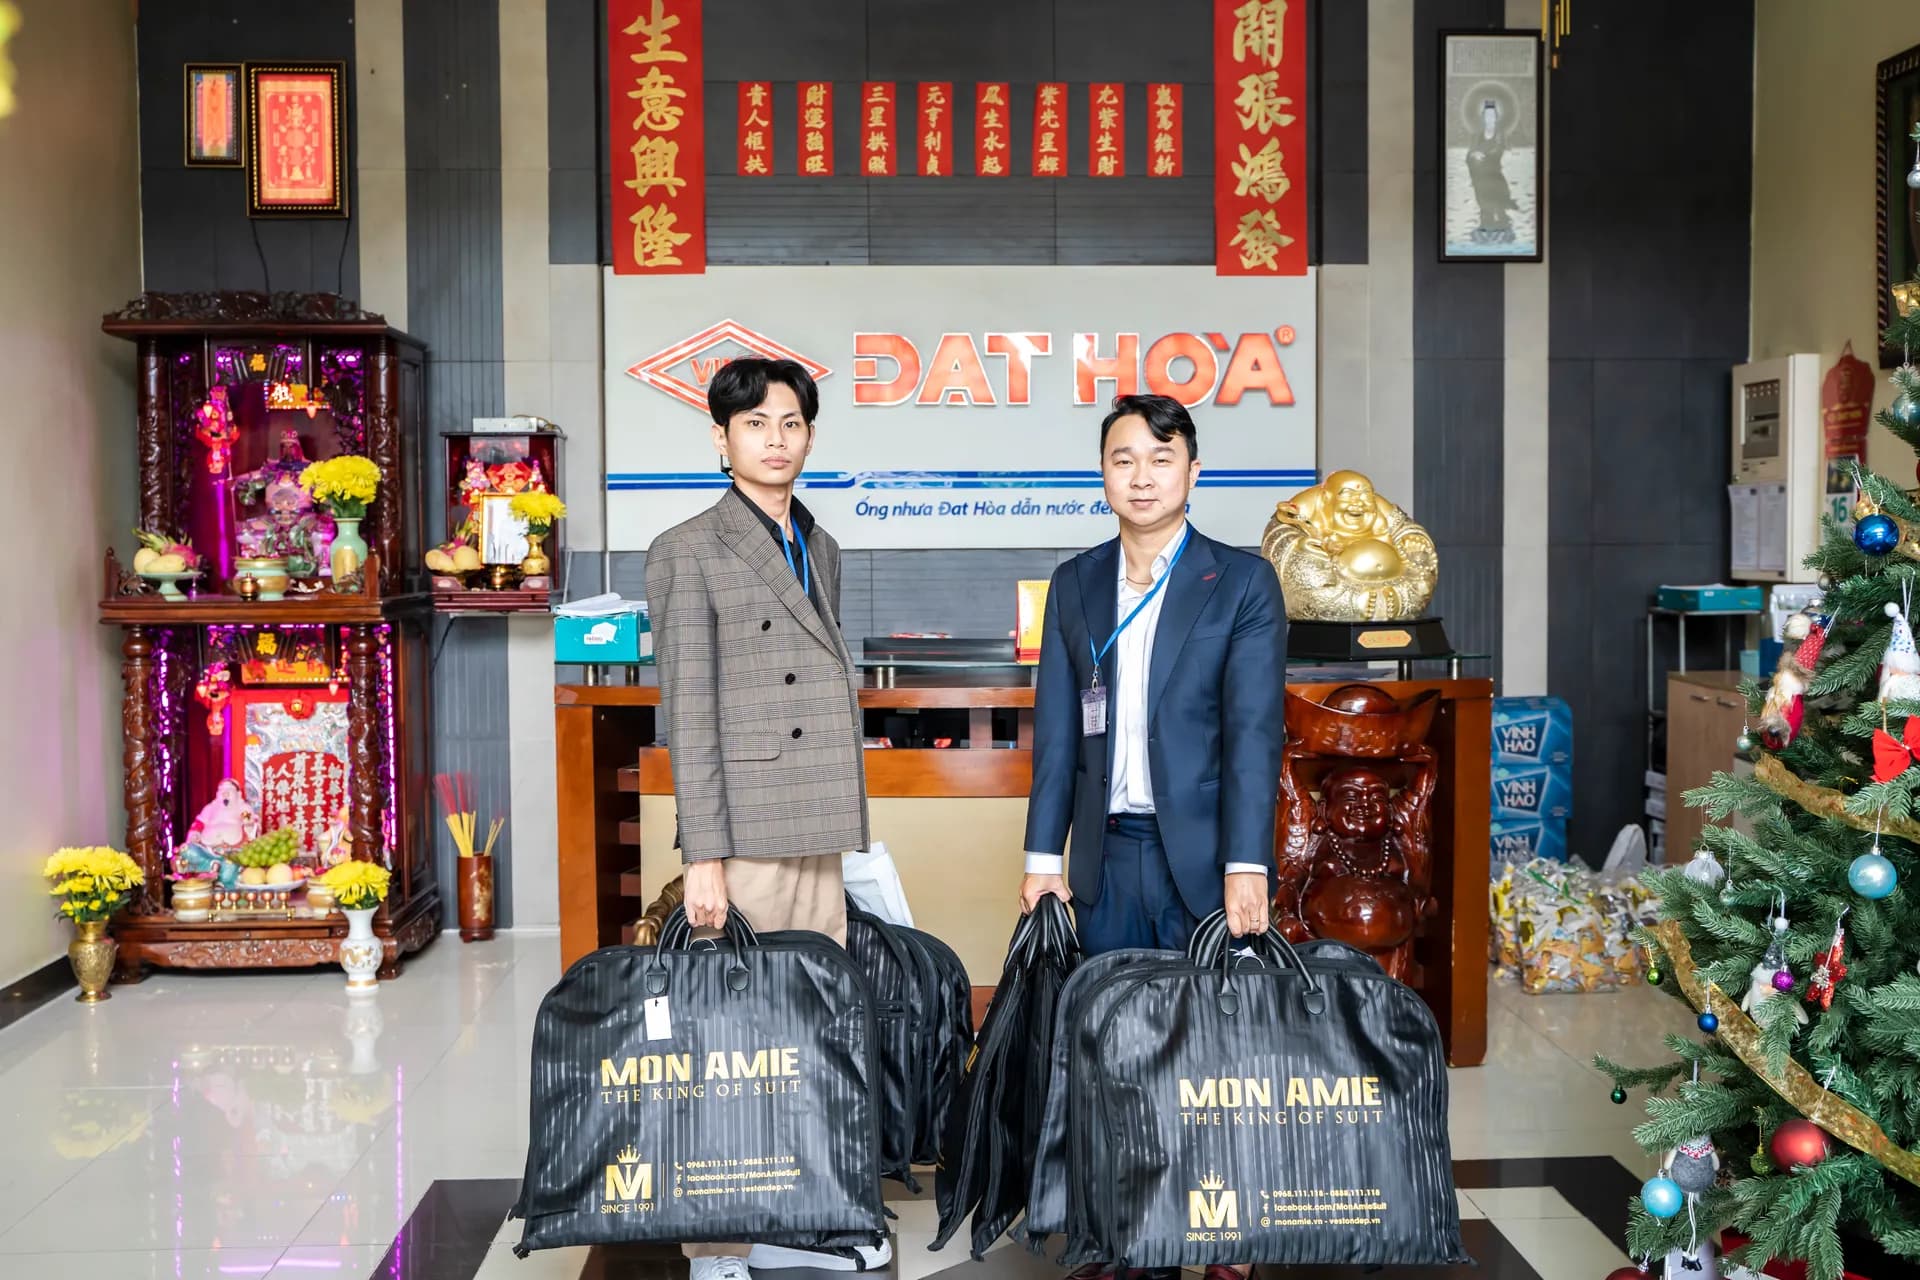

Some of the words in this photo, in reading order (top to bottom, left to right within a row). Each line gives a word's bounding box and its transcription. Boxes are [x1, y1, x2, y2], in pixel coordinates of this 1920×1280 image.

[622, 0, 692, 268] 生意興隆
[924, 85, 946, 176] 元亨利貞
[1230, 0, 1296, 271] 開張鴻發
[855, 496, 889, 520] Ống
[973, 500, 1006, 516] Hòa
[1011, 497, 1041, 515] dẫn
[1046, 499, 1085, 515] nước
[1831, 496, 1848, 523] 16
[256, 632, 277, 655] 福
[600, 1053, 691, 1087] MON
[705, 1047, 800, 1081] AMIE
[601, 1090, 642, 1104] THE
[653, 1084, 705, 1100] KING
[716, 1083, 742, 1097] OF
[754, 1080, 802, 1096] SUIT
[1179, 1077, 1272, 1108] MON
[1286, 1076, 1382, 1107] AMIE
[1180, 1112, 1222, 1125] THE
[1233, 1111, 1287, 1125] KING
[1298, 1111, 1325, 1124] OF
[1335, 1110, 1384, 1124] SUIT
[687, 1187, 735, 1196] monamie.vn
[600, 1203, 630, 1214] SINCE
[633, 1202, 654, 1213] 1991
[1186, 1231, 1217, 1242] SINCE
[1219, 1231, 1242, 1242] 1991
